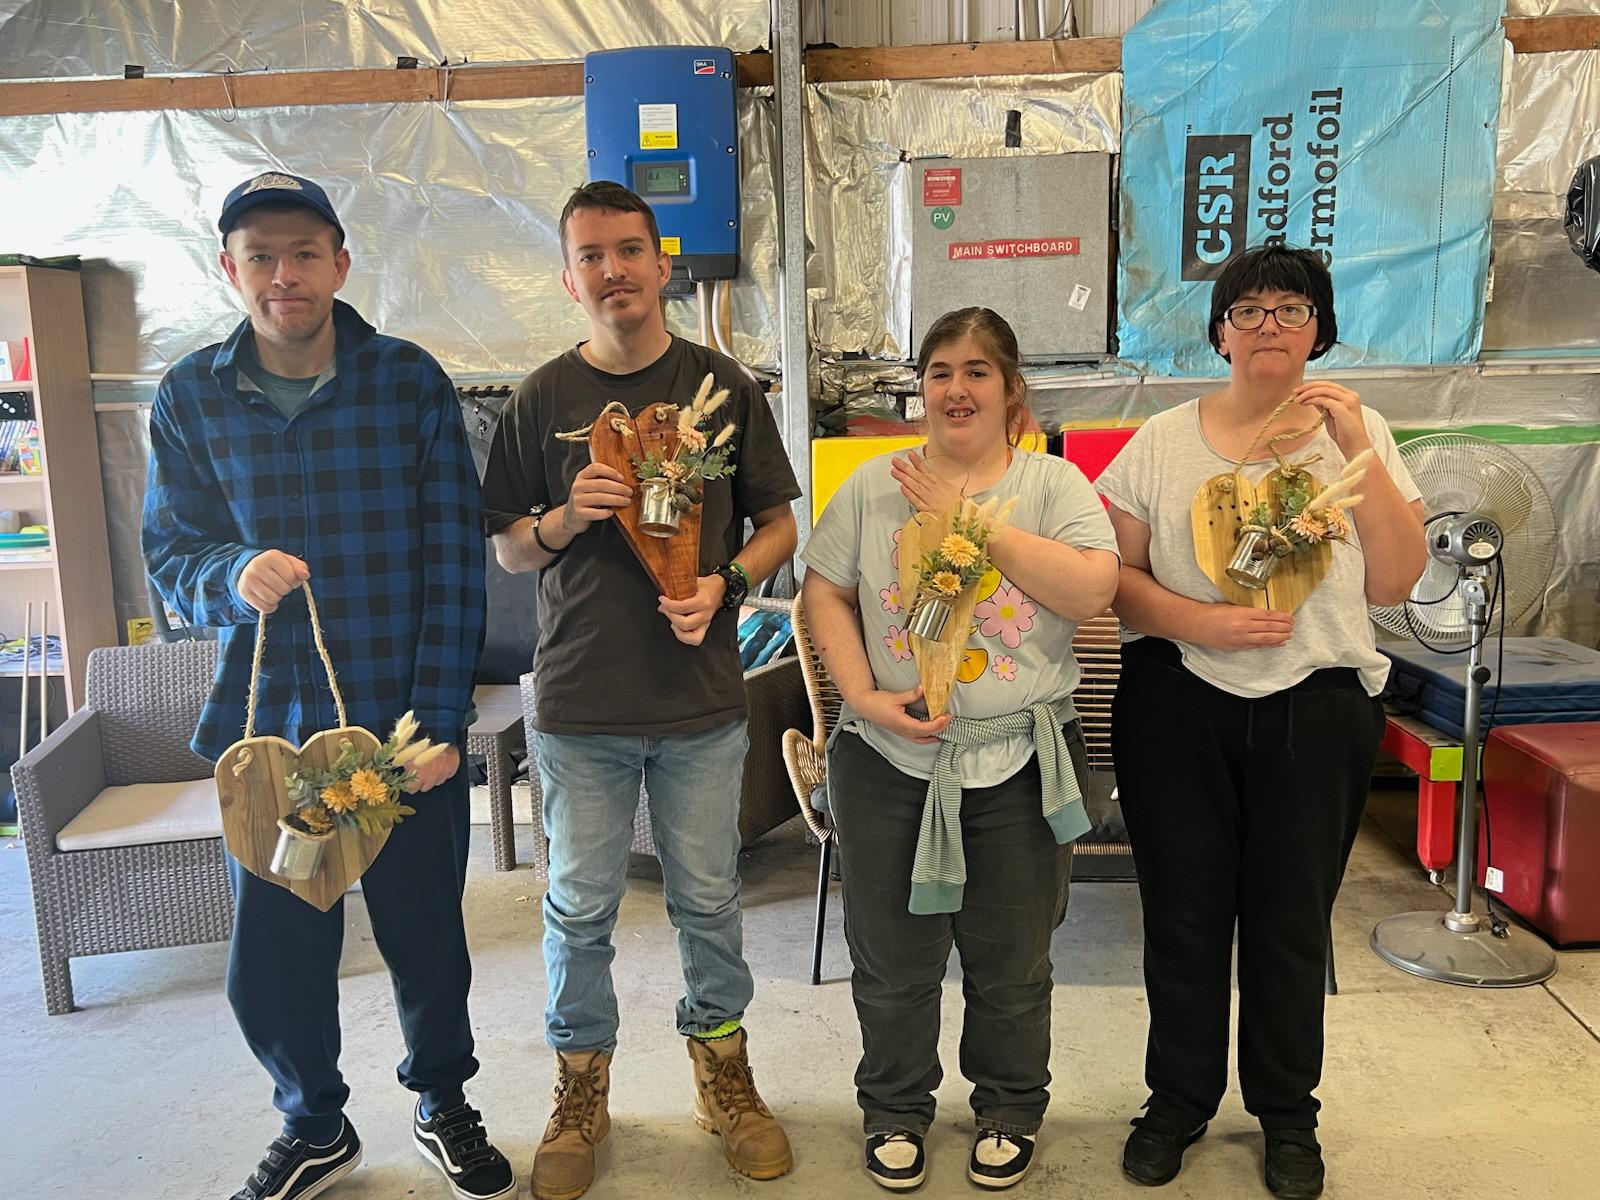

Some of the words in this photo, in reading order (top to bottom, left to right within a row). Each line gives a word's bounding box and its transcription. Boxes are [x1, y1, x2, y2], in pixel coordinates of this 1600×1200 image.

[1196, 153, 1235, 264] CSR
[934, 212, 951, 223] PV
[953, 245, 982, 258] MAIN
[987, 241, 1073, 256] SWITCHBOARD
